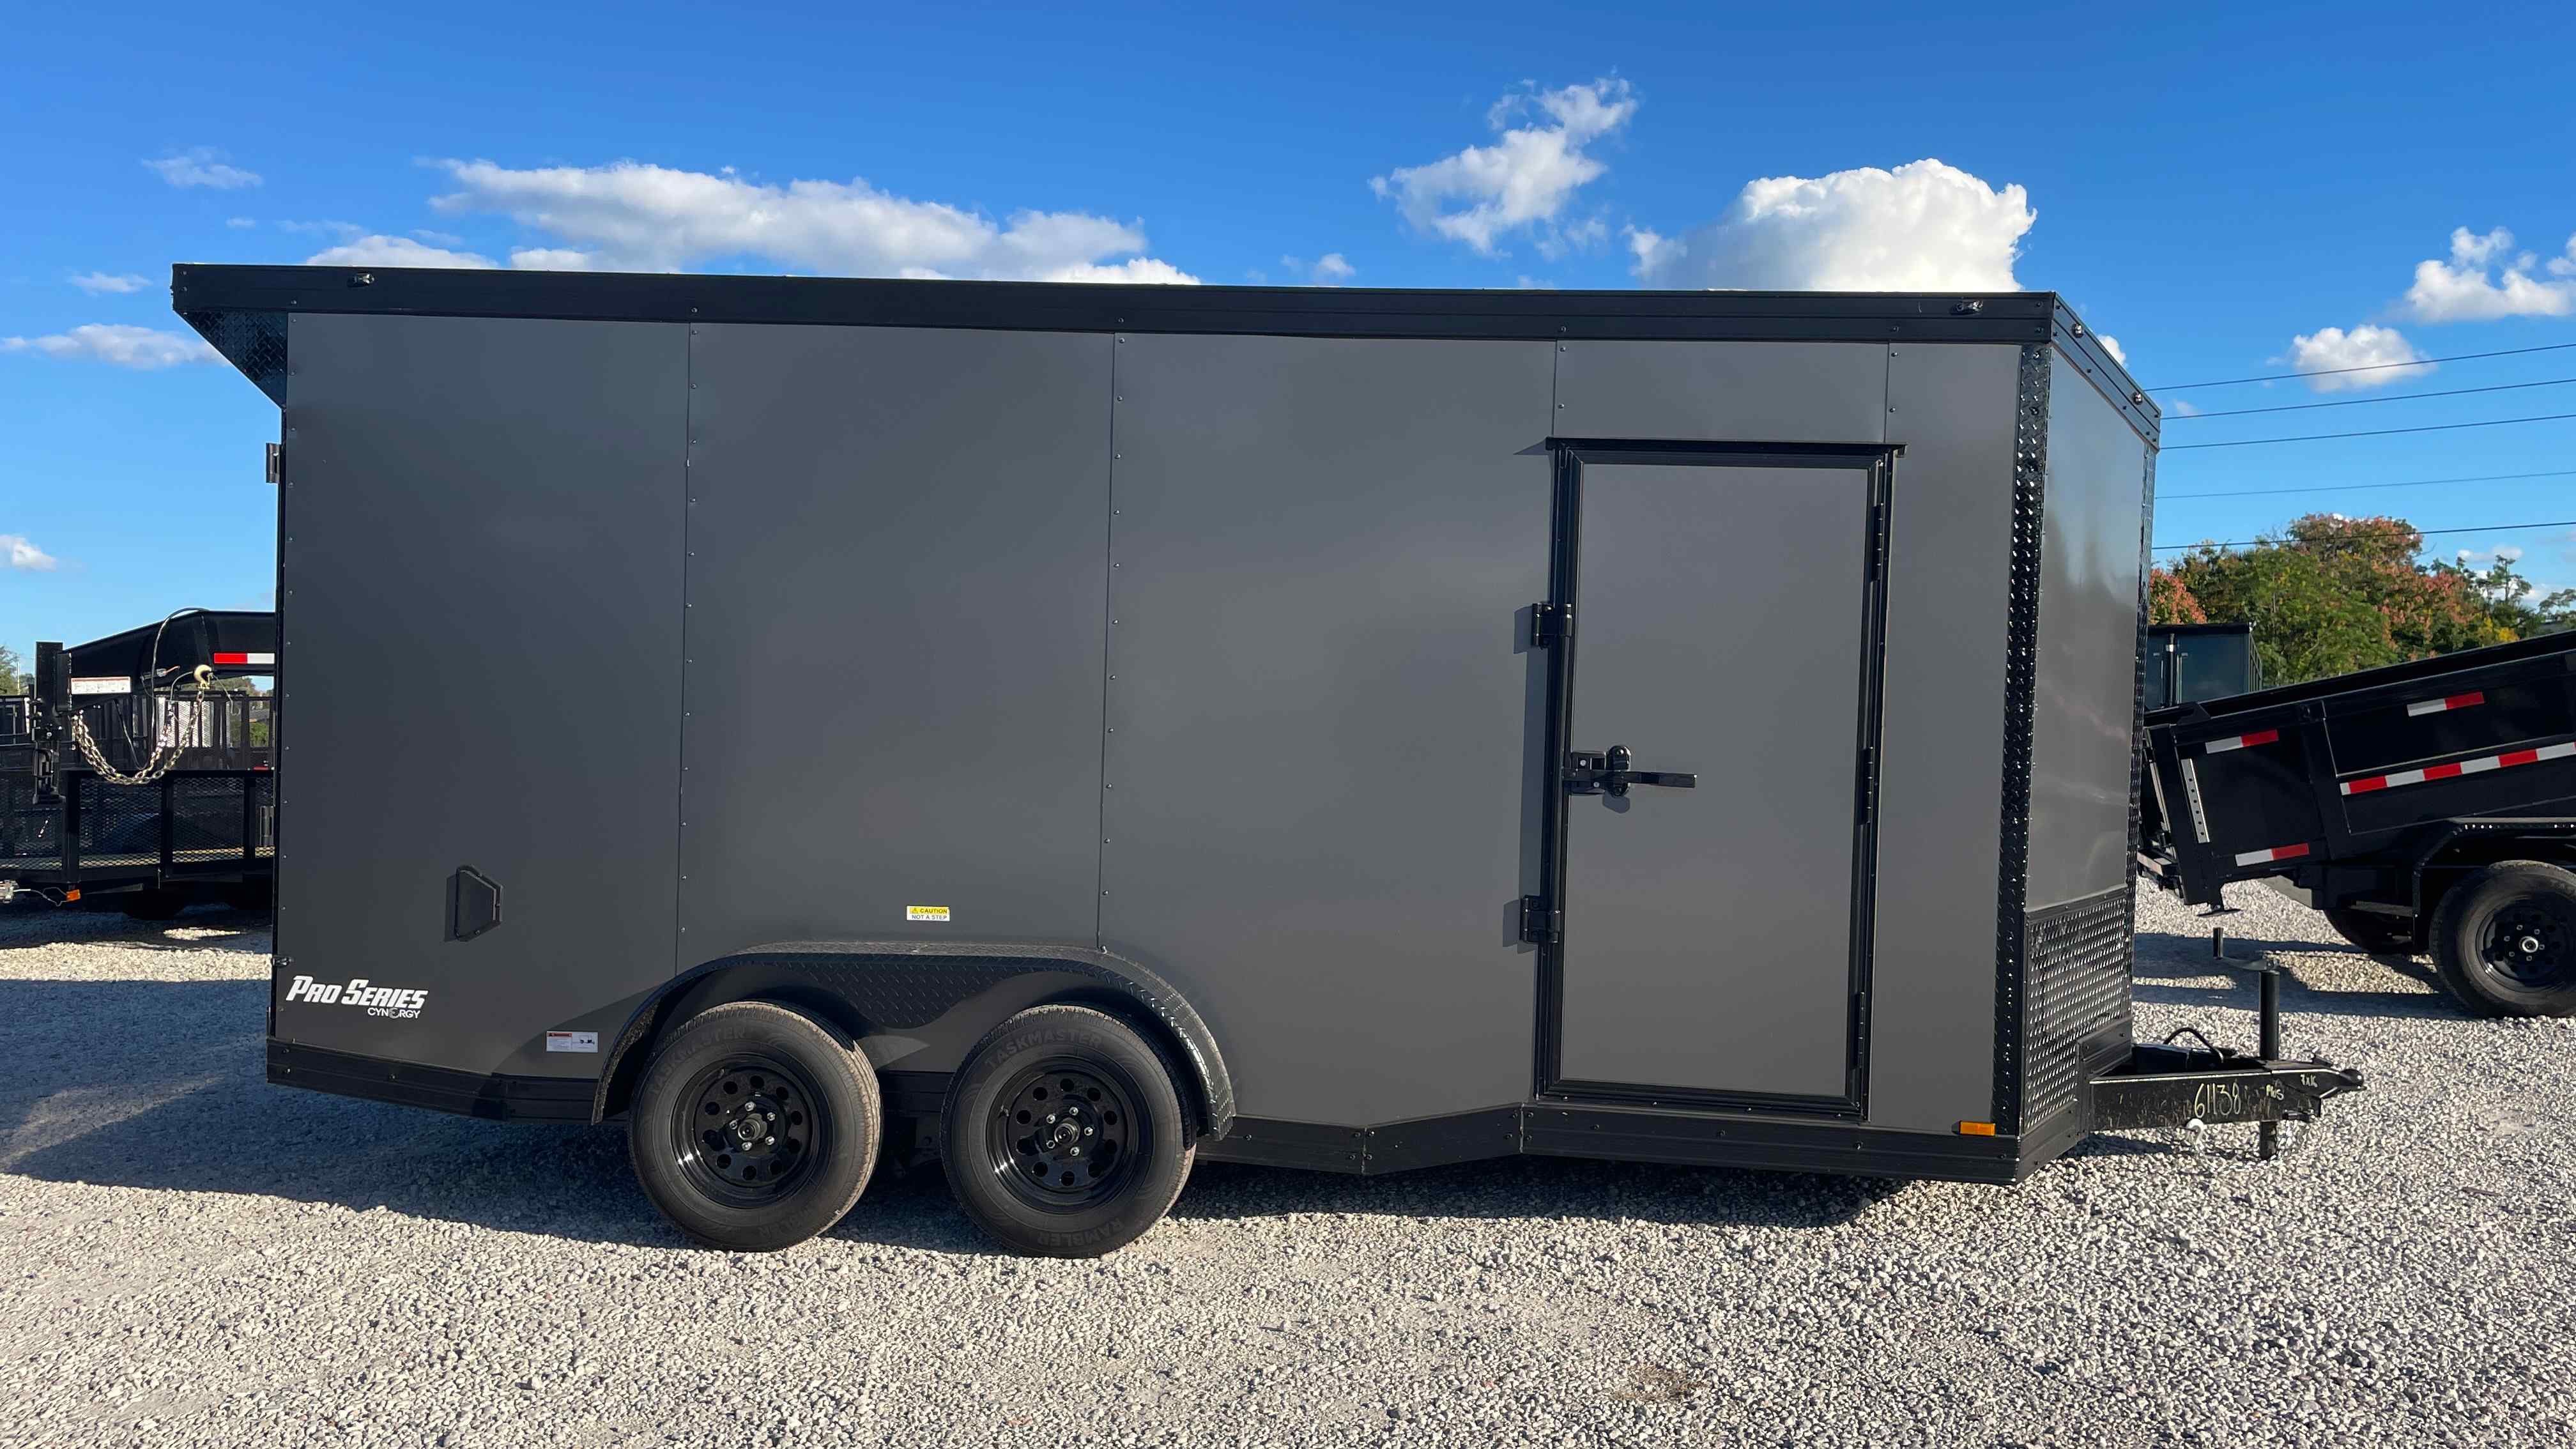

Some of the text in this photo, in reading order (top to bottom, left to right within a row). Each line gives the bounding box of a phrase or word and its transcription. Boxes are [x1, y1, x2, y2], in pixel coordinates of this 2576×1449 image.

[985, 1029, 1104, 1069] TASKMASTER
[2194, 1082, 2242, 1118] 61138
[1037, 1216, 1125, 1246] RAMBLER
